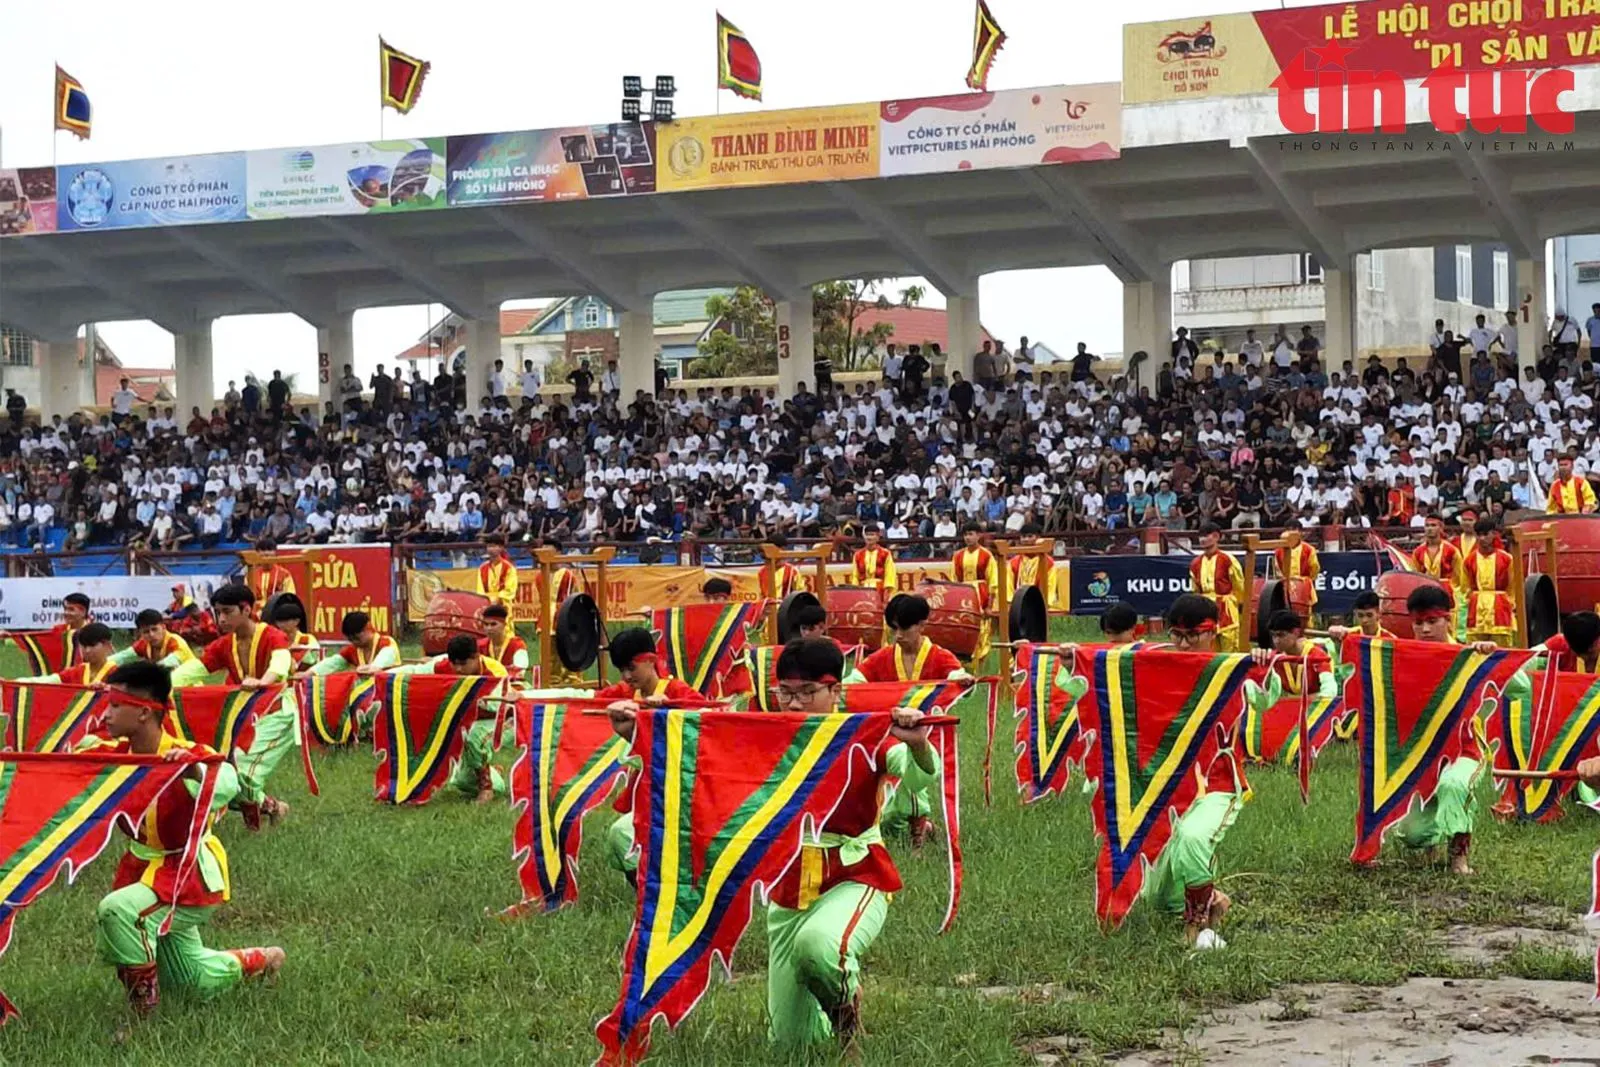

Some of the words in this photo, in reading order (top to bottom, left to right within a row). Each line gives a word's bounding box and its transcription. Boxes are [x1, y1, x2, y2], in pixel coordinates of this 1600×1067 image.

[1325, 5, 1359, 40] LỄ
[1377, 3, 1429, 37] HỘI
[1448, 0, 1522, 29] CHỌI
[1480, 29, 1548, 65] SẢN
[711, 135, 769, 158] THANH
[774, 126, 817, 153] BÌNH
[823, 125, 869, 150] MINH
[907, 126, 942, 140] CÔNG
[946, 126, 960, 137] TY
[888, 140, 967, 155] VIETPICTURES
[992, 134, 1036, 148] PHÒNG
[513, 166, 528, 177] CA
[711, 159, 740, 174] BÁNH
[744, 159, 779, 172] TRUNG
[782, 157, 803, 168] THU
[806, 155, 823, 167] GIA
[130, 184, 162, 197] CÔNG
[164, 184, 177, 194] TY
[1127, 579, 1164, 592] KHU
[1169, 579, 1194, 592] DU
